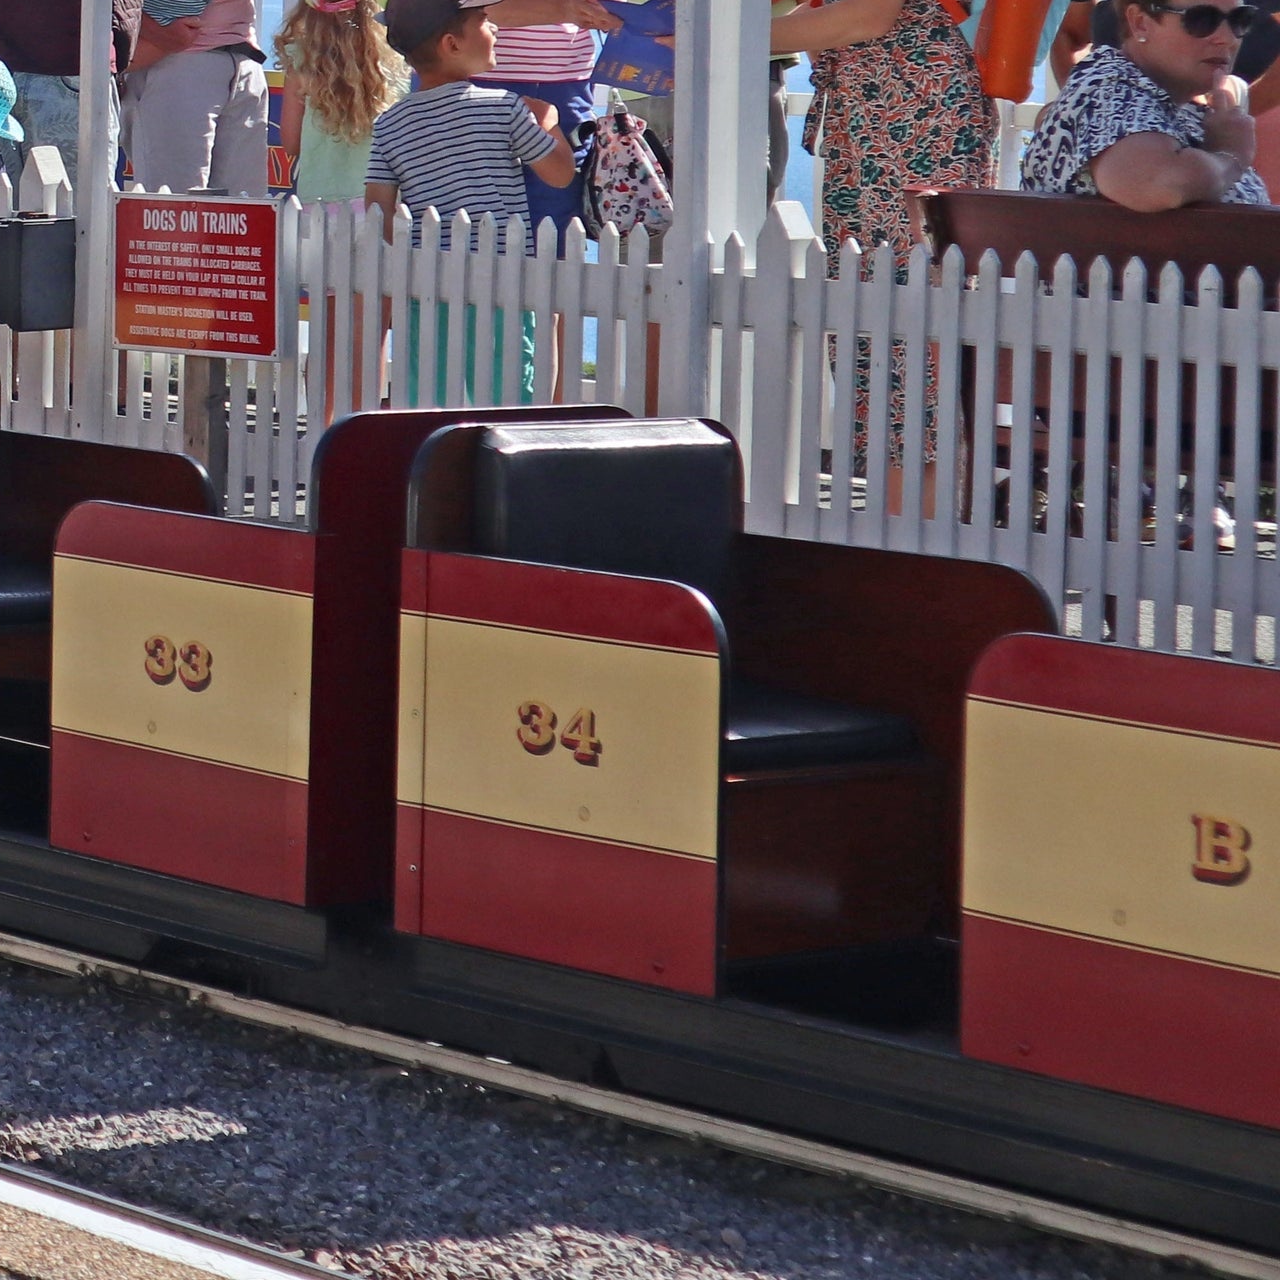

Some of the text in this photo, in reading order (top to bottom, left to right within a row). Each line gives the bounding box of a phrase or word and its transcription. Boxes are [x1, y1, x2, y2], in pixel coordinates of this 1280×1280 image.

[144, 209, 247, 236] DOGS ON TRAINS
[129, 240, 262, 257] IN THE INTEREST OF SAFETY, ONLY SMALL DOGS ARE
[125, 268, 266, 286] THEY MUST BE HELD ON YOUR LAP BY THEIR COLLAR AT
[124, 283, 267, 300] ALL TIMES TO PREVENT THEM JUMPING FROM THE TRAIN.
[135, 305, 254, 322] STATION MASTER'S DISCRETION WILL BE USED.
[144, 634, 214, 692] 33
[516, 699, 603, 766] 34
